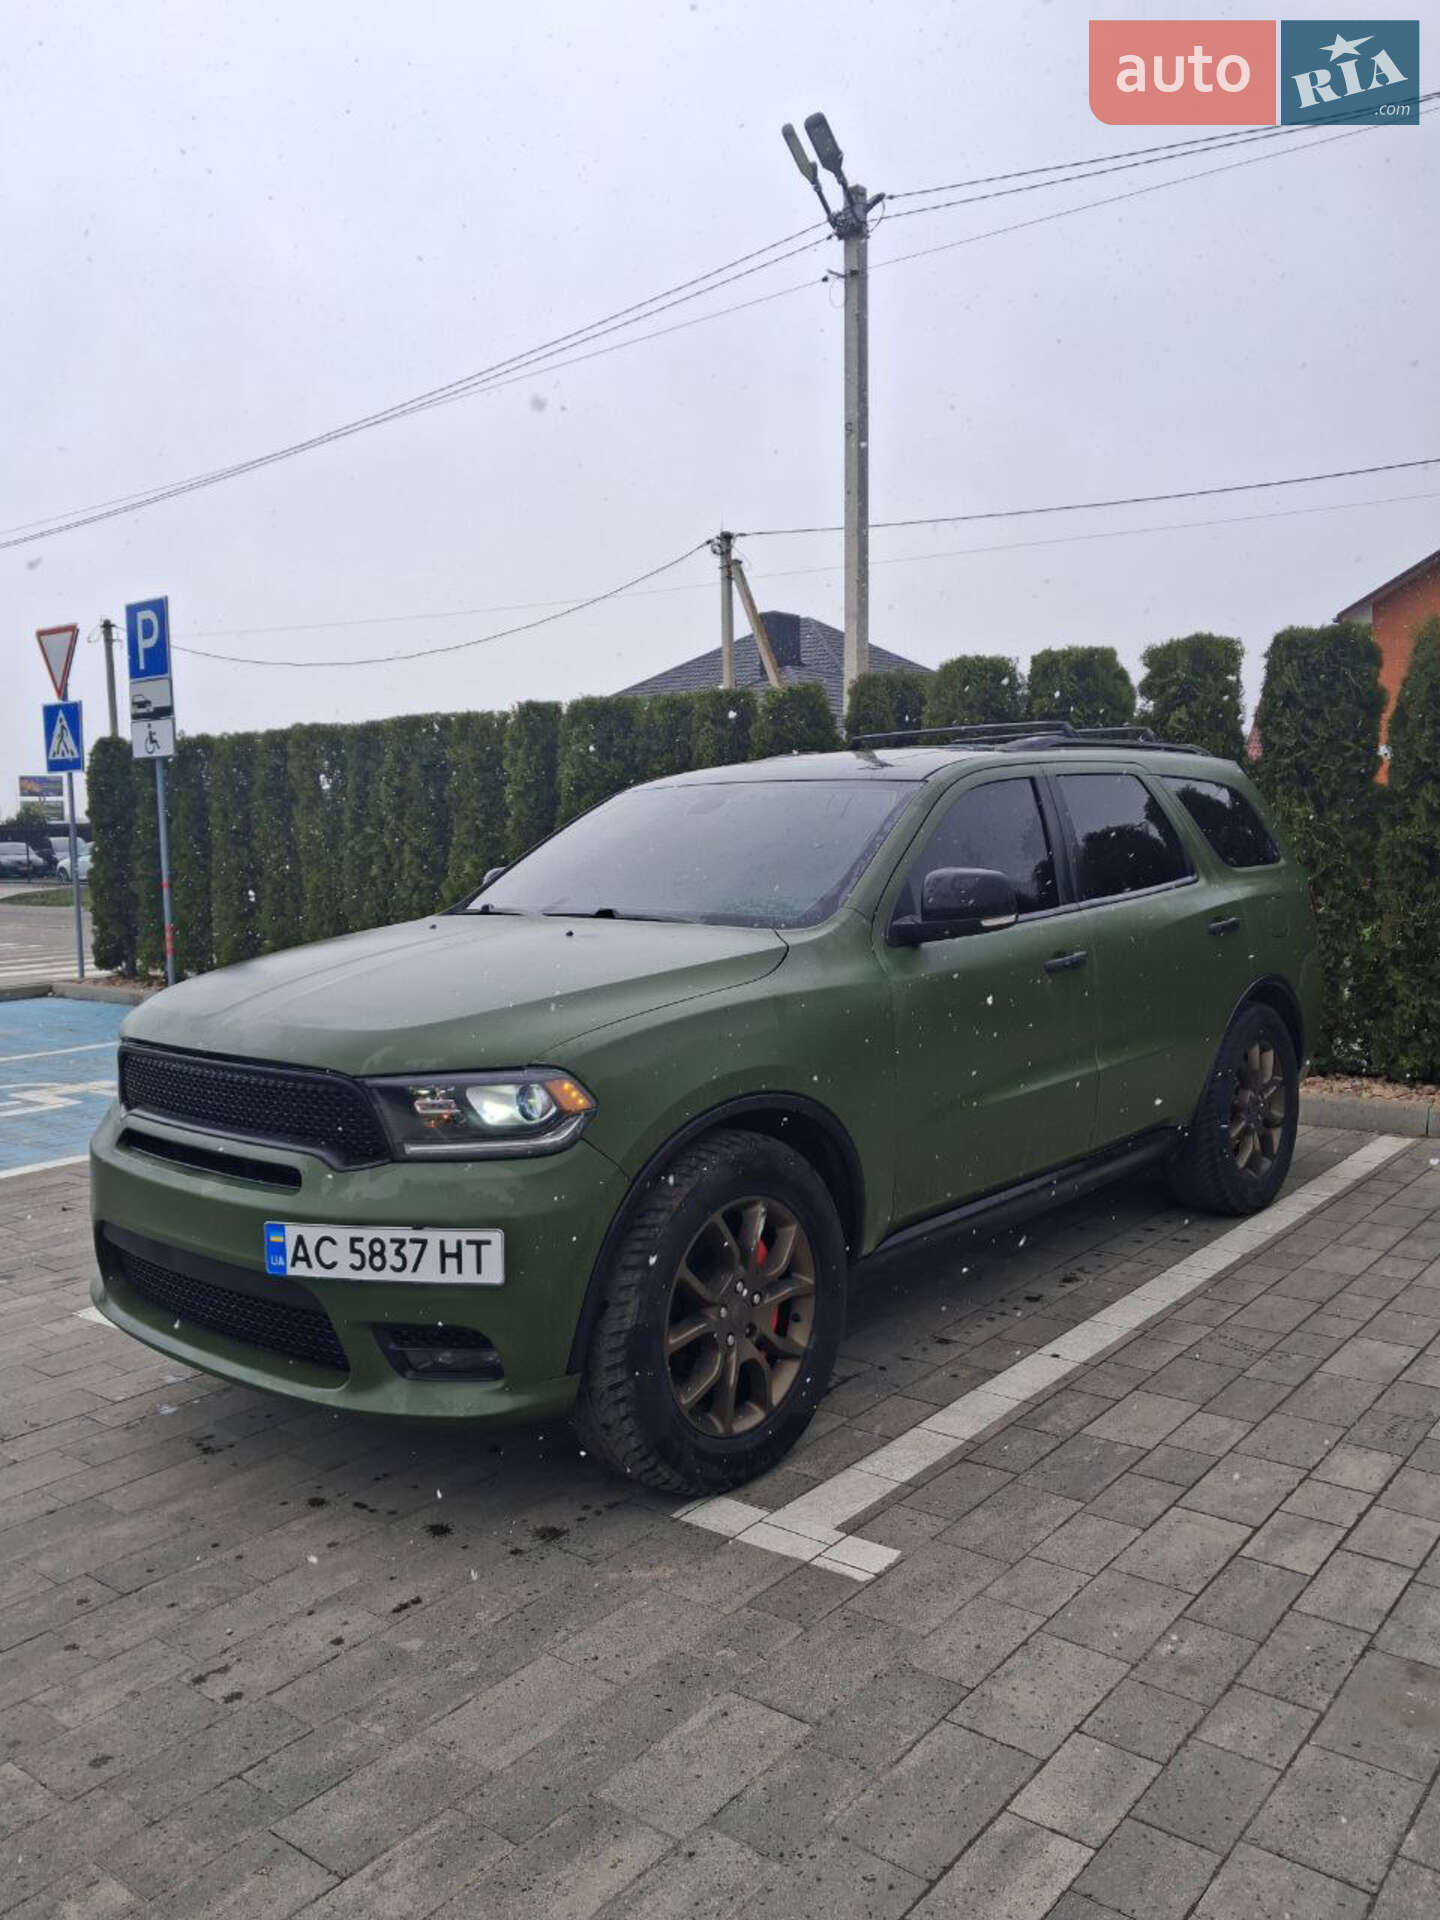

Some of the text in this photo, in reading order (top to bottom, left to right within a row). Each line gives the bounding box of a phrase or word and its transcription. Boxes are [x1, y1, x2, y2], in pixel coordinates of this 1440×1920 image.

[136, 609, 159, 671] P
[270, 1255, 285, 1266] UA
[290, 1234, 492, 1275] AC 5837 HT
